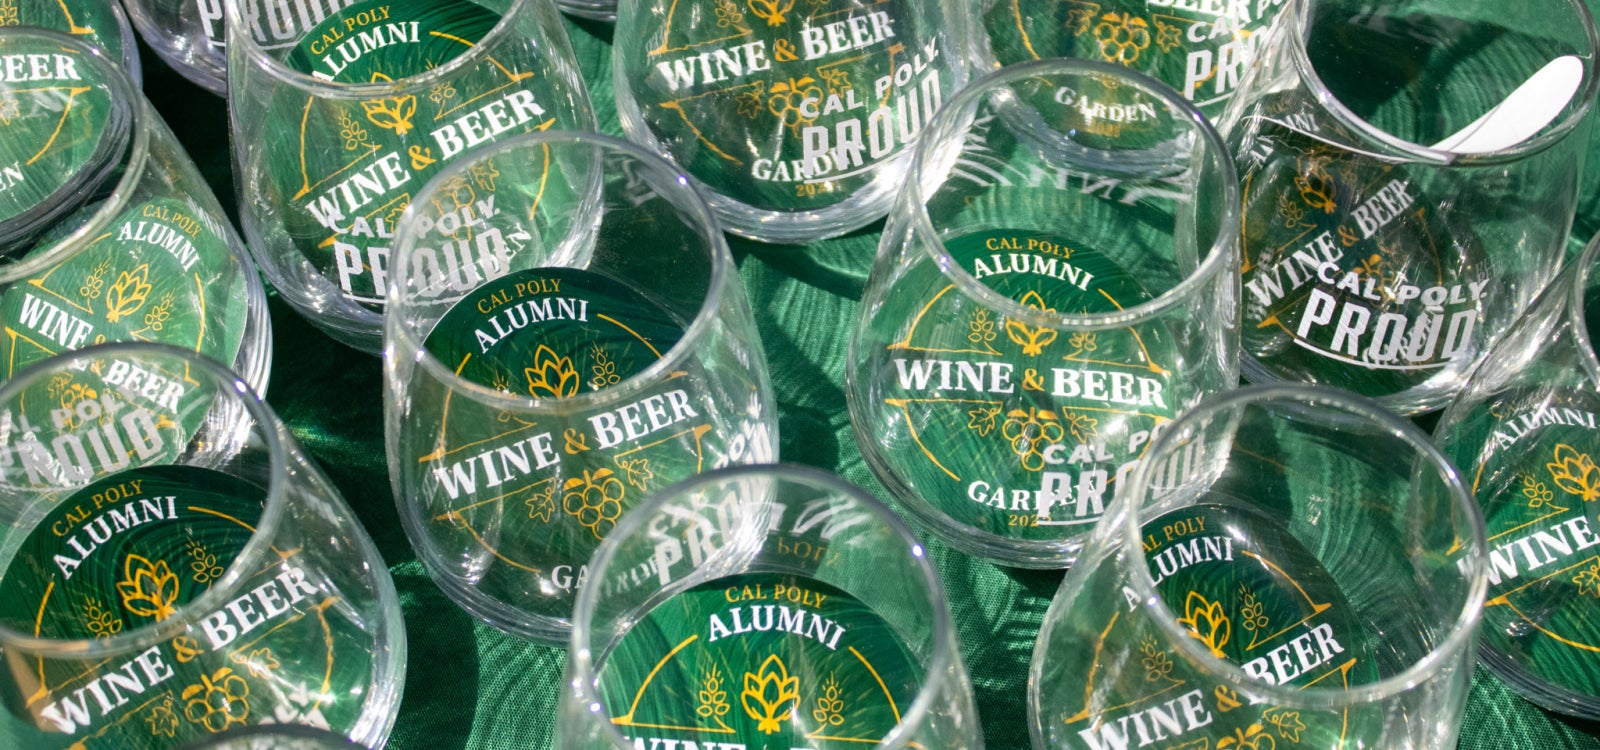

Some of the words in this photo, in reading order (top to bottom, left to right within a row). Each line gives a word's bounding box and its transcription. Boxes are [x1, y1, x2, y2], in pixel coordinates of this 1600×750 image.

[310, 29, 344, 55] CAL
[344, 6, 390, 32] POLY
[312, 21, 420, 82] ALUMNI
[656, 40, 771, 91] WINE
[774, 38, 799, 62] &
[799, 11, 895, 62] BEER
[0, 53, 82, 82] EER
[800, 89, 865, 119] CAL
[803, 69, 942, 177] PROUD
[305, 151, 411, 228] WINE
[408, 145, 437, 170] &
[430, 89, 545, 161] BEER
[117, 221, 200, 272] ALUMNI
[143, 204, 170, 221] CAL
[171, 212, 202, 238] POLY
[1245, 230, 1345, 308] WINE
[1337, 225, 1360, 247] &
[1351, 178, 1415, 240] BEER
[973, 253, 1095, 292] ALUMNI
[986, 238, 1023, 251] CAL
[1027, 239, 1075, 260] POLY
[477, 289, 513, 314] CAL
[516, 278, 562, 300] POLY
[1318, 262, 1381, 301] CAL
[473, 297, 590, 354] ALUMNI
[1297, 288, 1478, 362] PROUD
[102, 359, 186, 414] BEER
[893, 358, 1015, 394] WINE
[1022, 368, 1045, 391] &
[1051, 367, 1169, 409] BEER
[436, 432, 561, 500] WINE
[565, 428, 591, 455] &
[588, 388, 698, 449] BEER
[1043, 442, 1114, 465] CAL
[1493, 406, 1598, 451] ALUMNI
[52, 508, 91, 537] CAL
[93, 479, 144, 511] POLY
[1008, 514, 1050, 527] 202
[52, 495, 179, 580] ALUMNI
[1141, 534, 1162, 556] AL
[1163, 515, 1207, 541] POLY
[1484, 515, 1600, 587] WINE
[724, 584, 767, 602] CAL
[774, 584, 828, 609] POLY
[41, 645, 175, 736] WINE
[172, 635, 204, 664] &
[200, 566, 320, 650] BEER
[707, 604, 847, 650] ALUMNI
[1078, 688, 1213, 750] WINE
[1214, 684, 1243, 712] &
[1241, 621, 1345, 688] BEER
